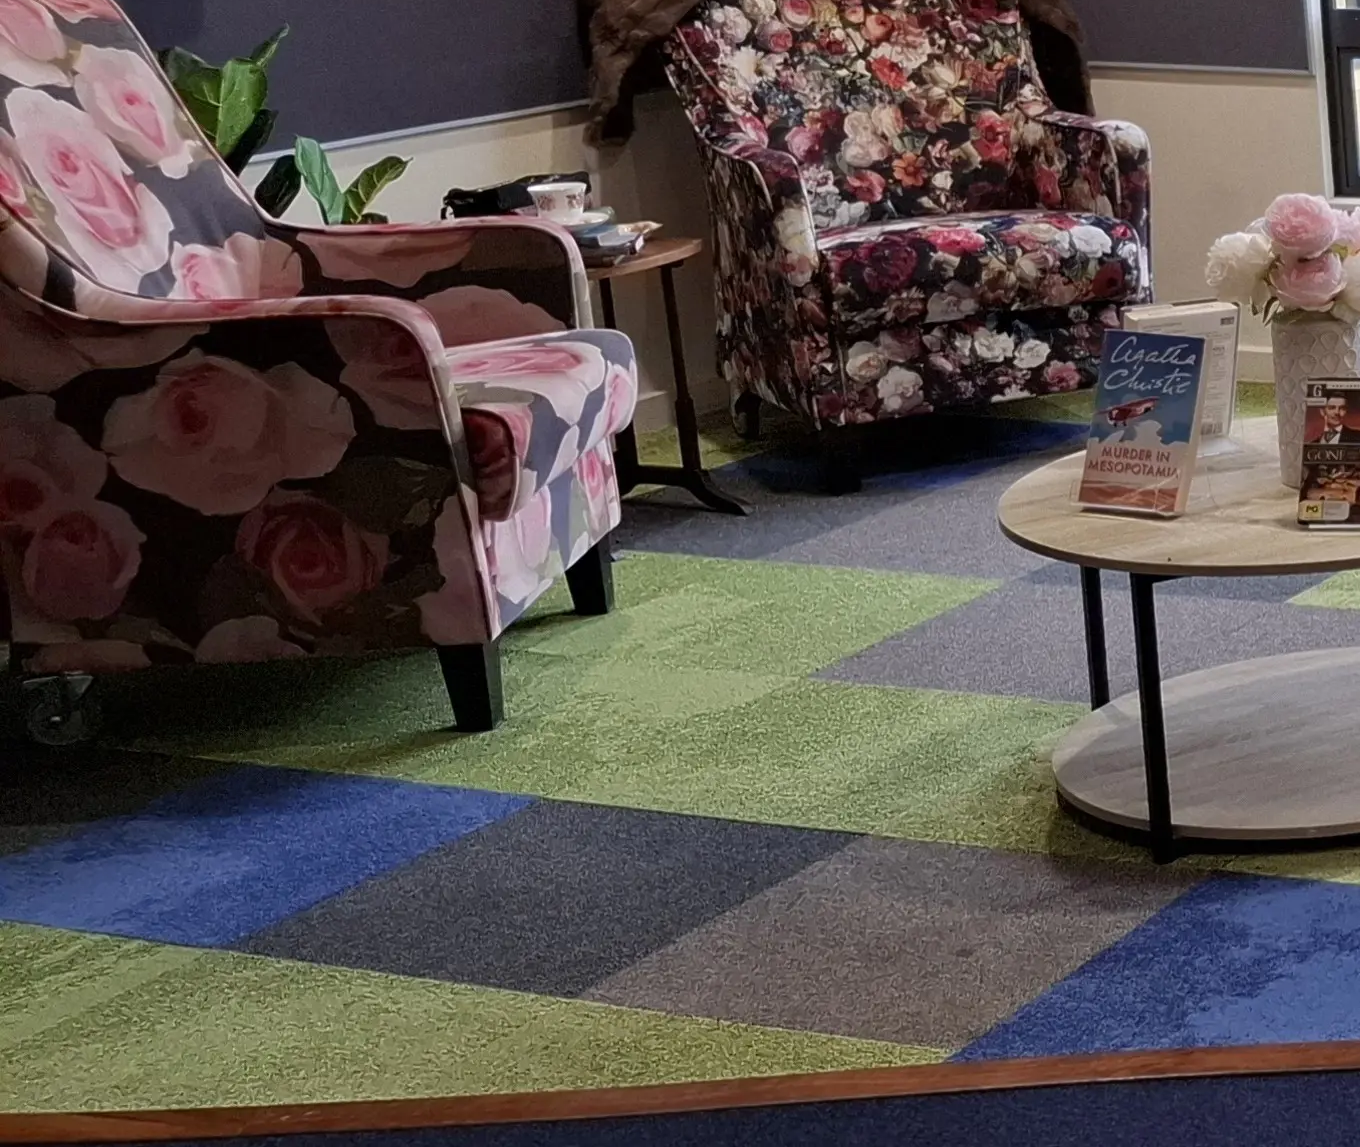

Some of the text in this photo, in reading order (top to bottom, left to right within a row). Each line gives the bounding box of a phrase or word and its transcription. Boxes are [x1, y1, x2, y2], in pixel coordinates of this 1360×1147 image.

[1110, 336, 1197, 371] Agatha
[1103, 365, 1193, 395] Christie
[1101, 446, 1171, 463] MURDER IN
[1087, 459, 1180, 480] MESOPOTAMIA
